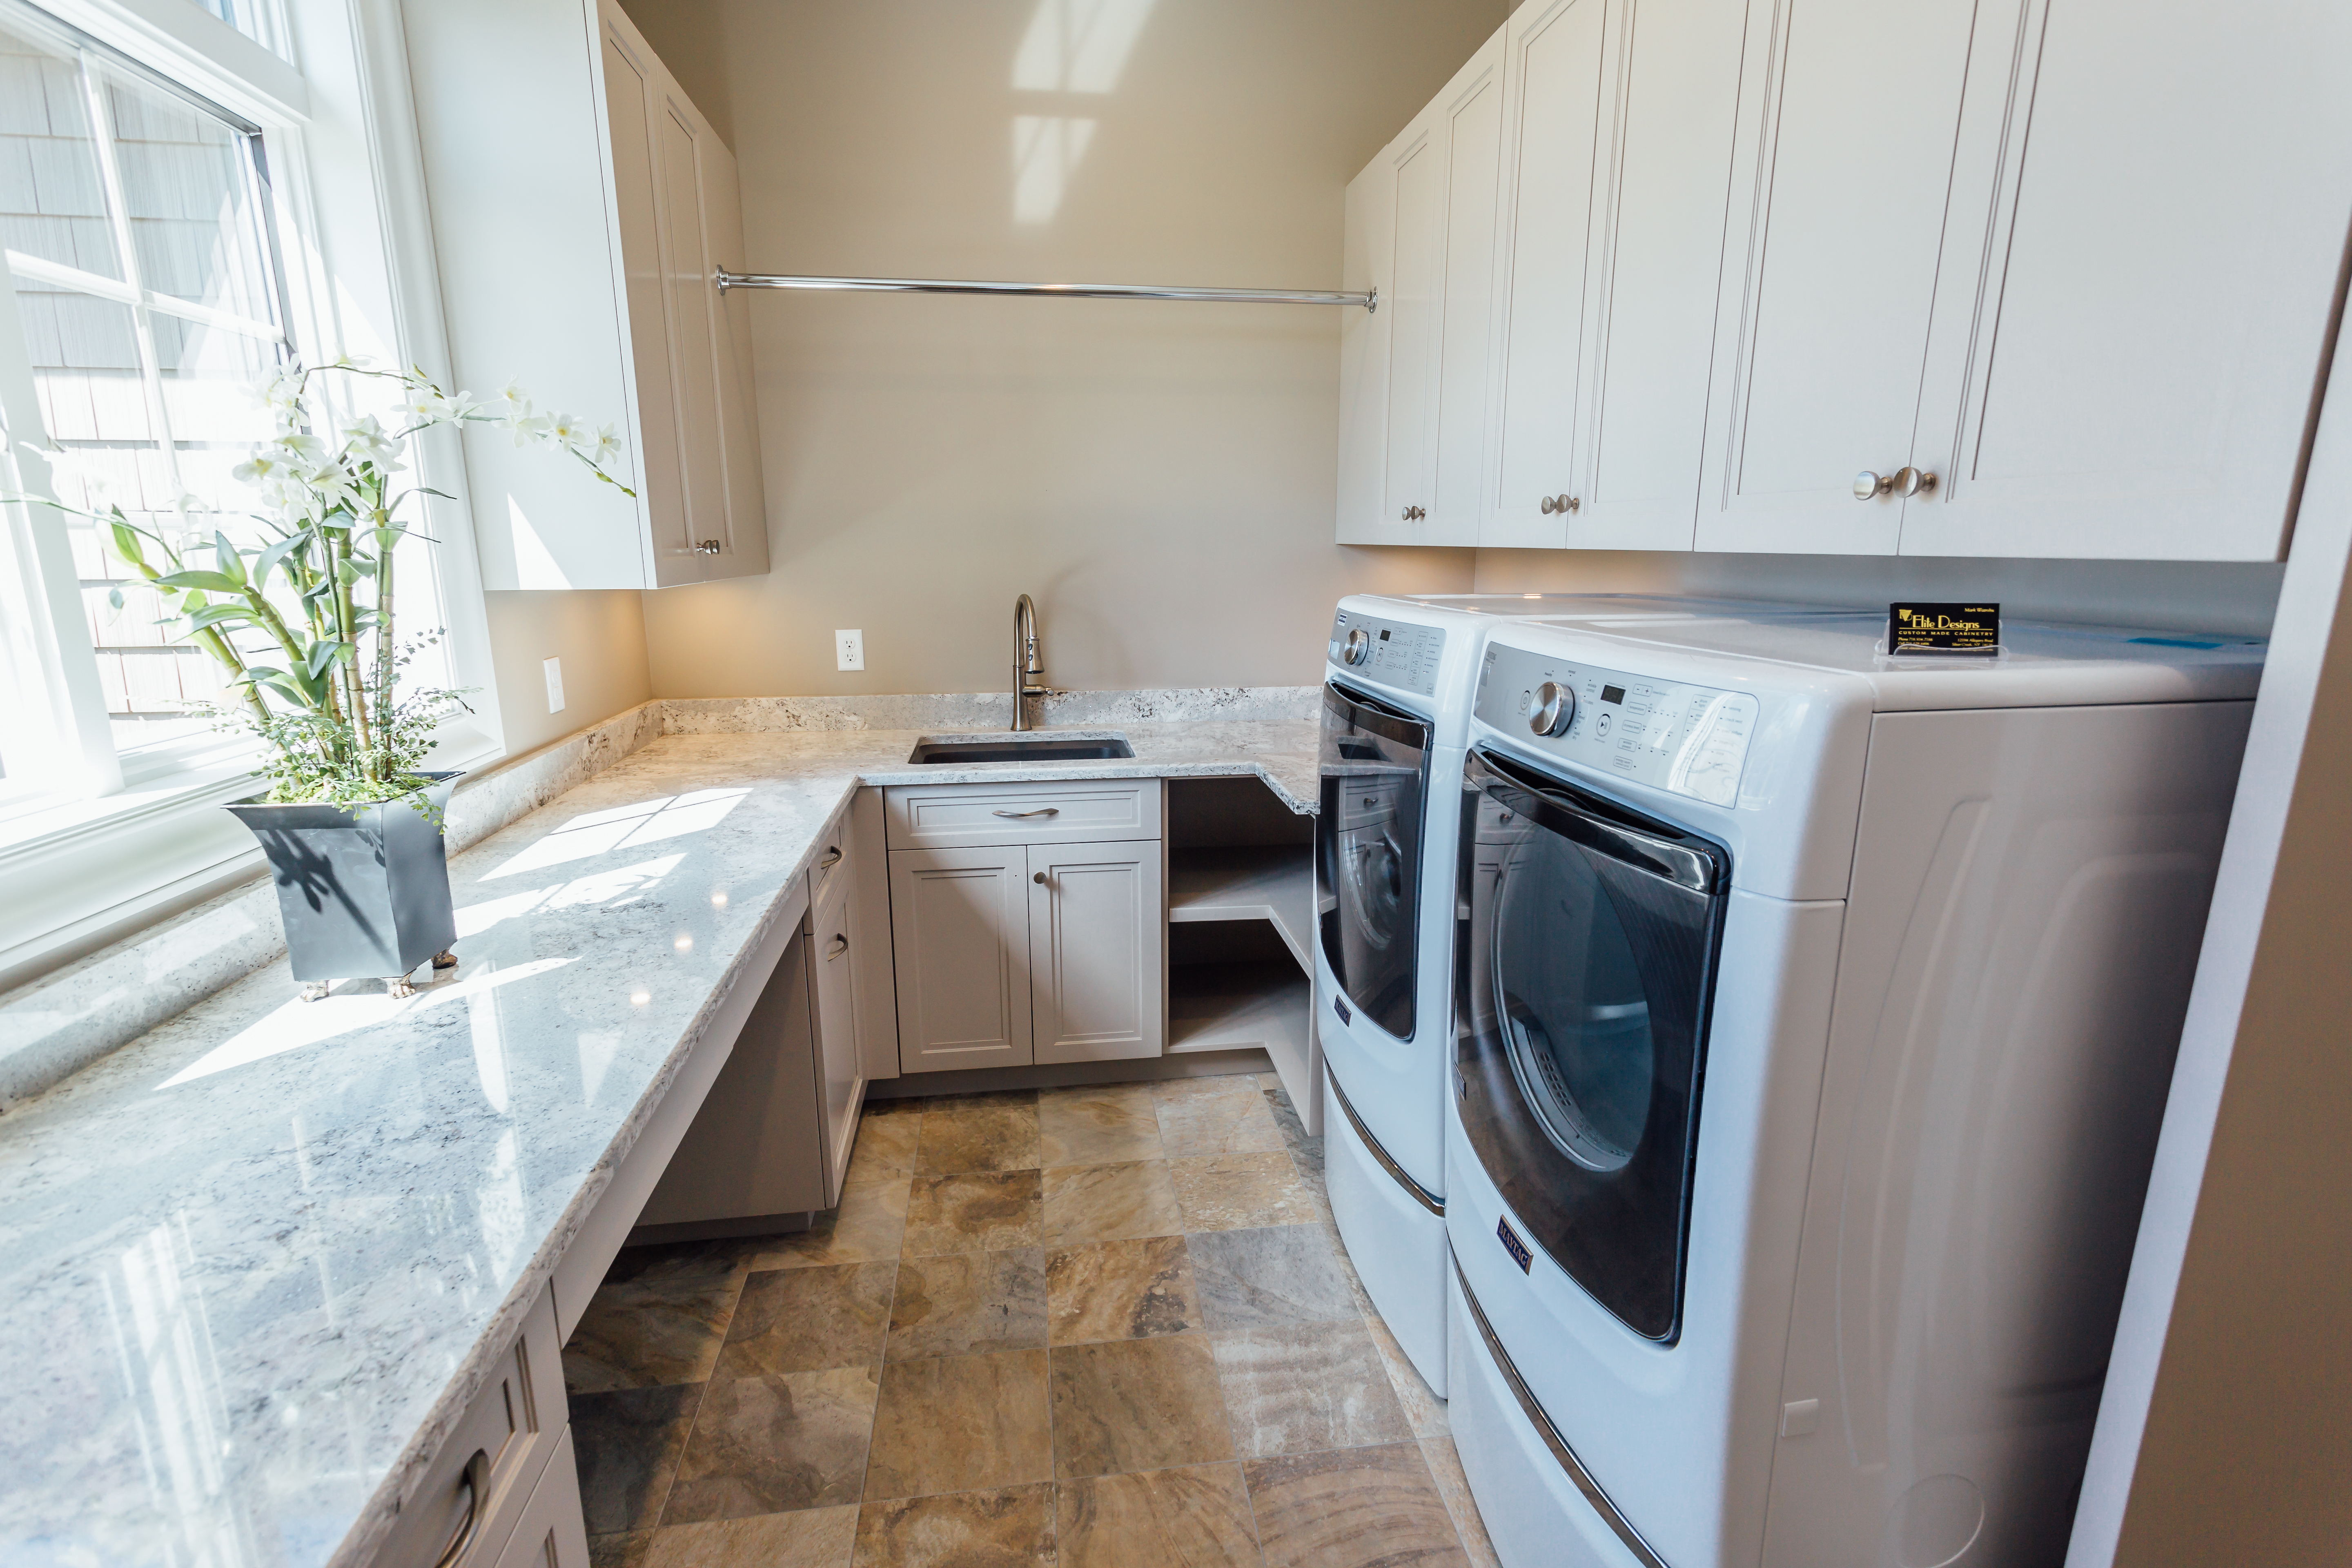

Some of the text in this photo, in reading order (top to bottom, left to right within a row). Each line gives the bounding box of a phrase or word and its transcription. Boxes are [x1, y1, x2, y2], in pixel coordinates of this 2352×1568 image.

[1913, 615, 1980, 631] Elite Designs
[1336, 1000, 1348, 1021] MAYTAG
[1499, 1223, 1528, 1266] MAYTAG
